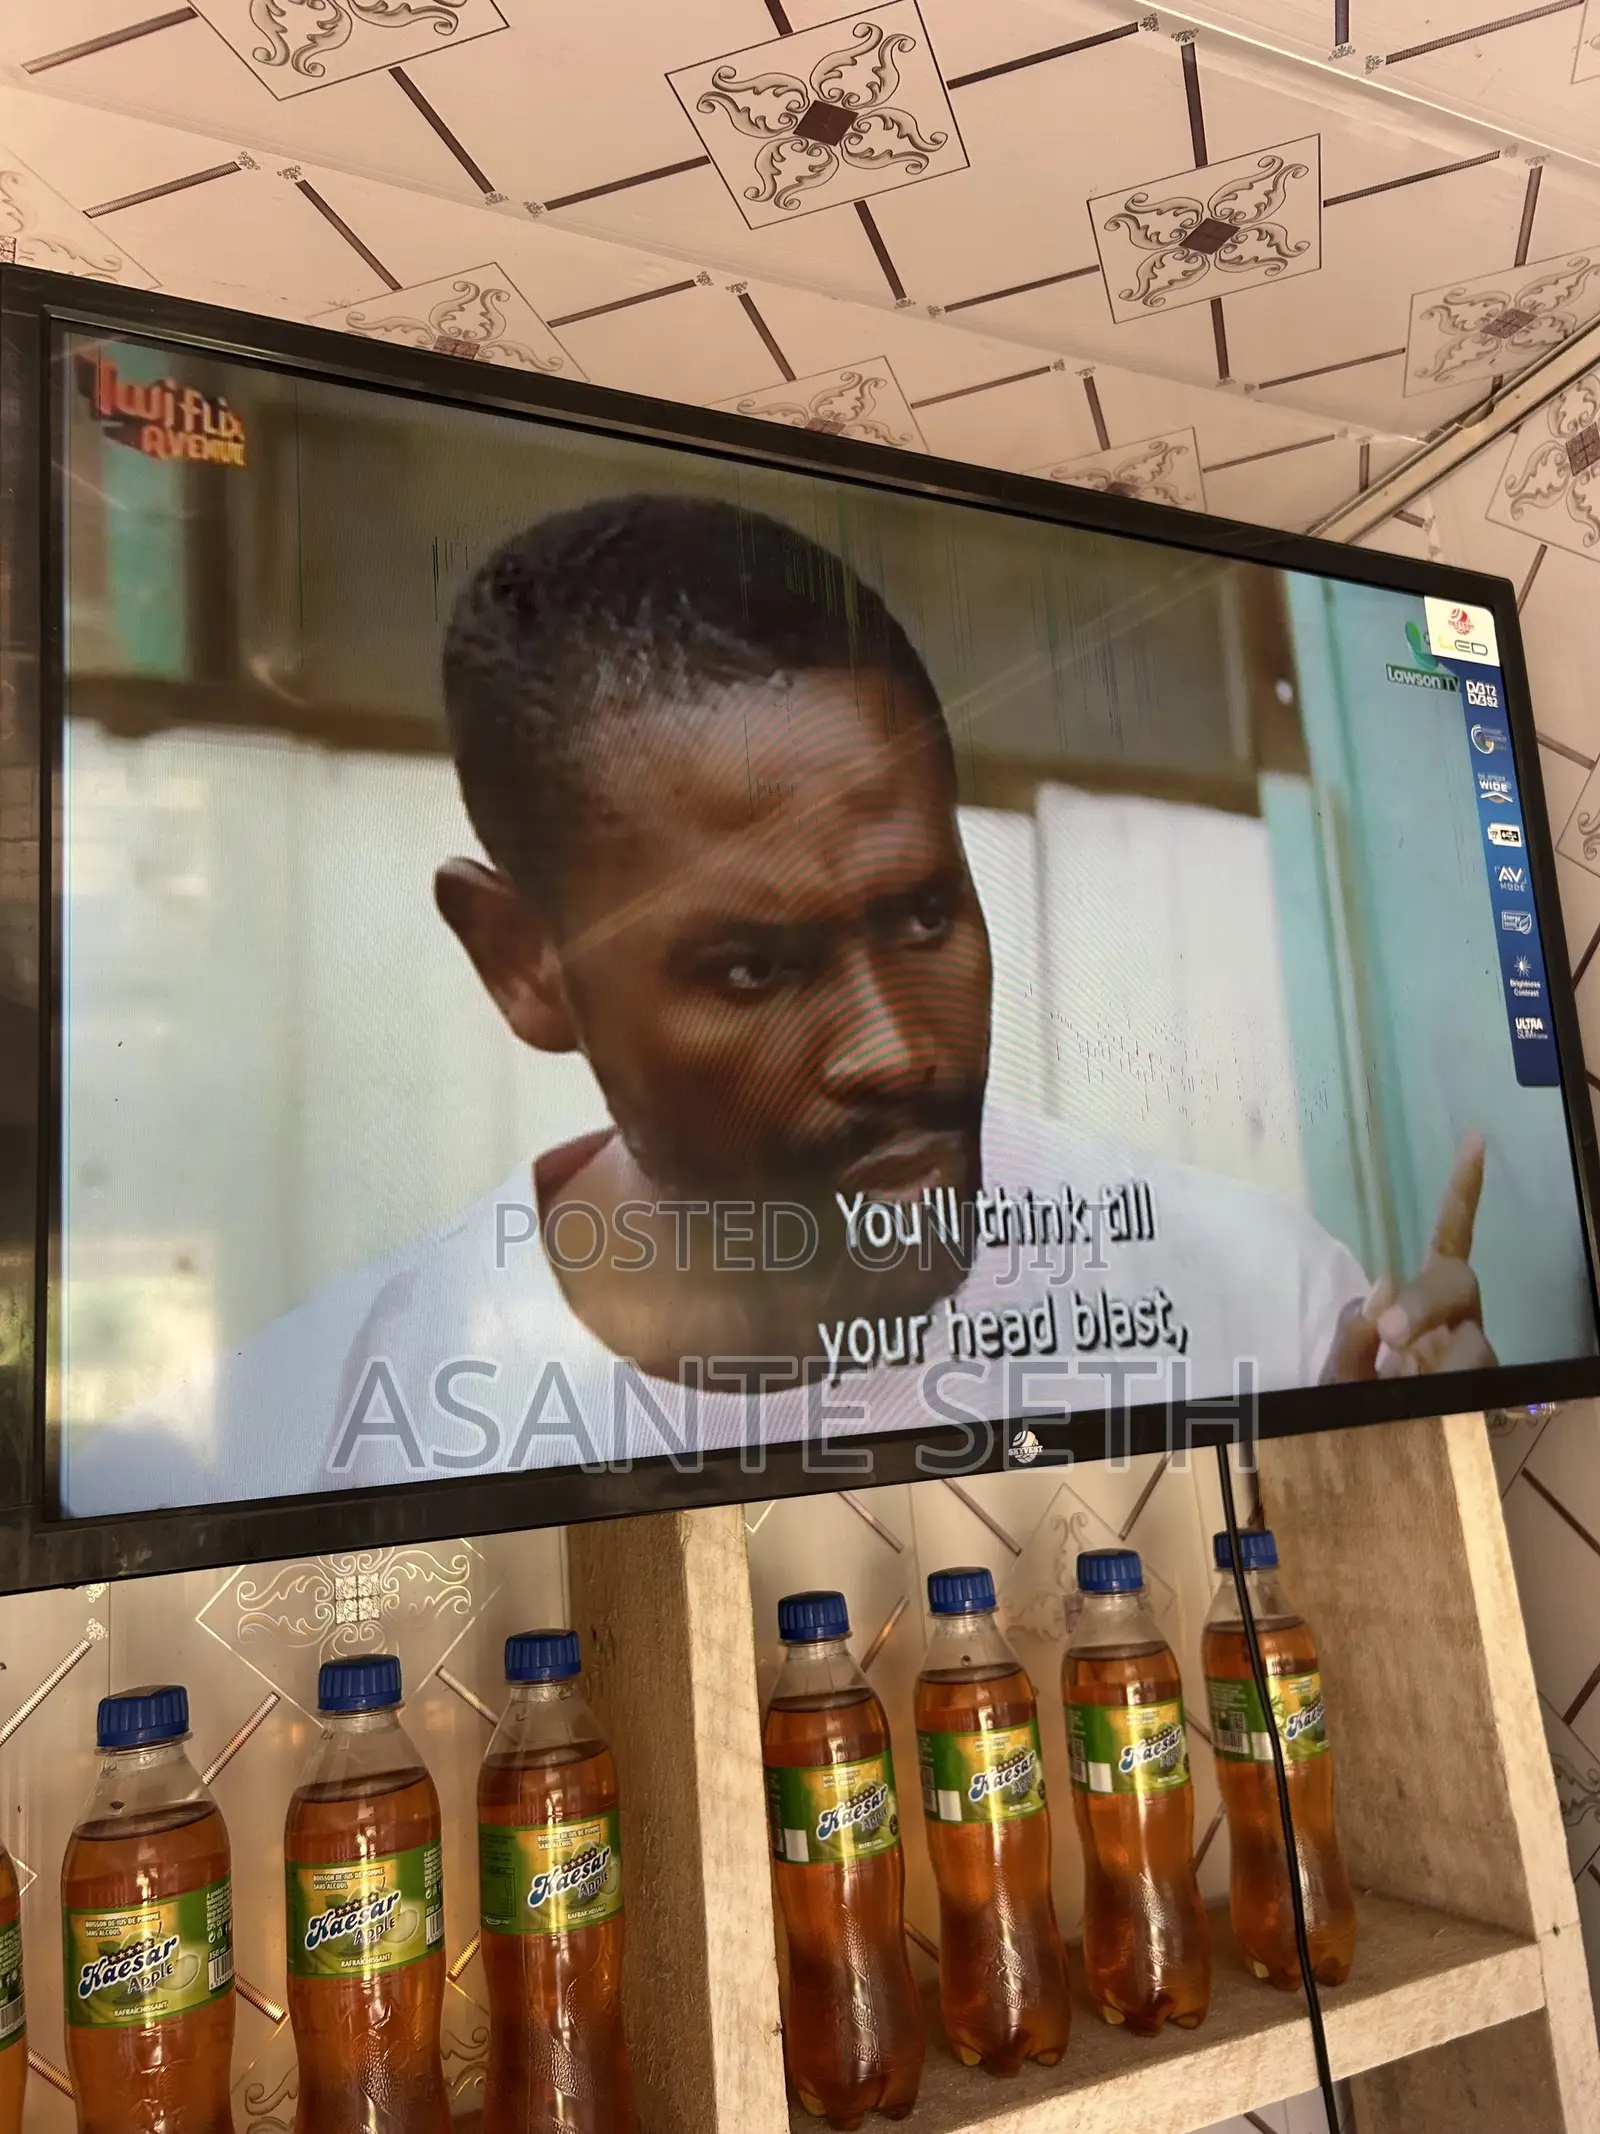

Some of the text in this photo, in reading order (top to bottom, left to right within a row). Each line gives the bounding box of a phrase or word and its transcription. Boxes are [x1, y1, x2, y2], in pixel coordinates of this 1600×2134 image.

[1438, 636, 1488, 656] LED
[1387, 665, 1460, 692] Lawson TV
[1479, 780, 1508, 793] WIDE
[1499, 866, 1522, 883] AV
[1500, 882, 1526, 892] MODE
[1515, 1017, 1543, 1030] ULTRA
[835, 1186, 961, 1248] You'll
[977, 1183, 1091, 1248] think
[818, 1287, 1190, 1389] your head blast,
[968, 1750, 1037, 1802] Kaesar
[816, 1783, 889, 1840] Kaesar
[528, 1845, 611, 1908] Kaesar
[305, 1890, 402, 1951] Kaesar
[354, 1916, 396, 1946] Apple
[78, 1935, 180, 1999] Kaesar
[127, 1962, 174, 1995] Apple
